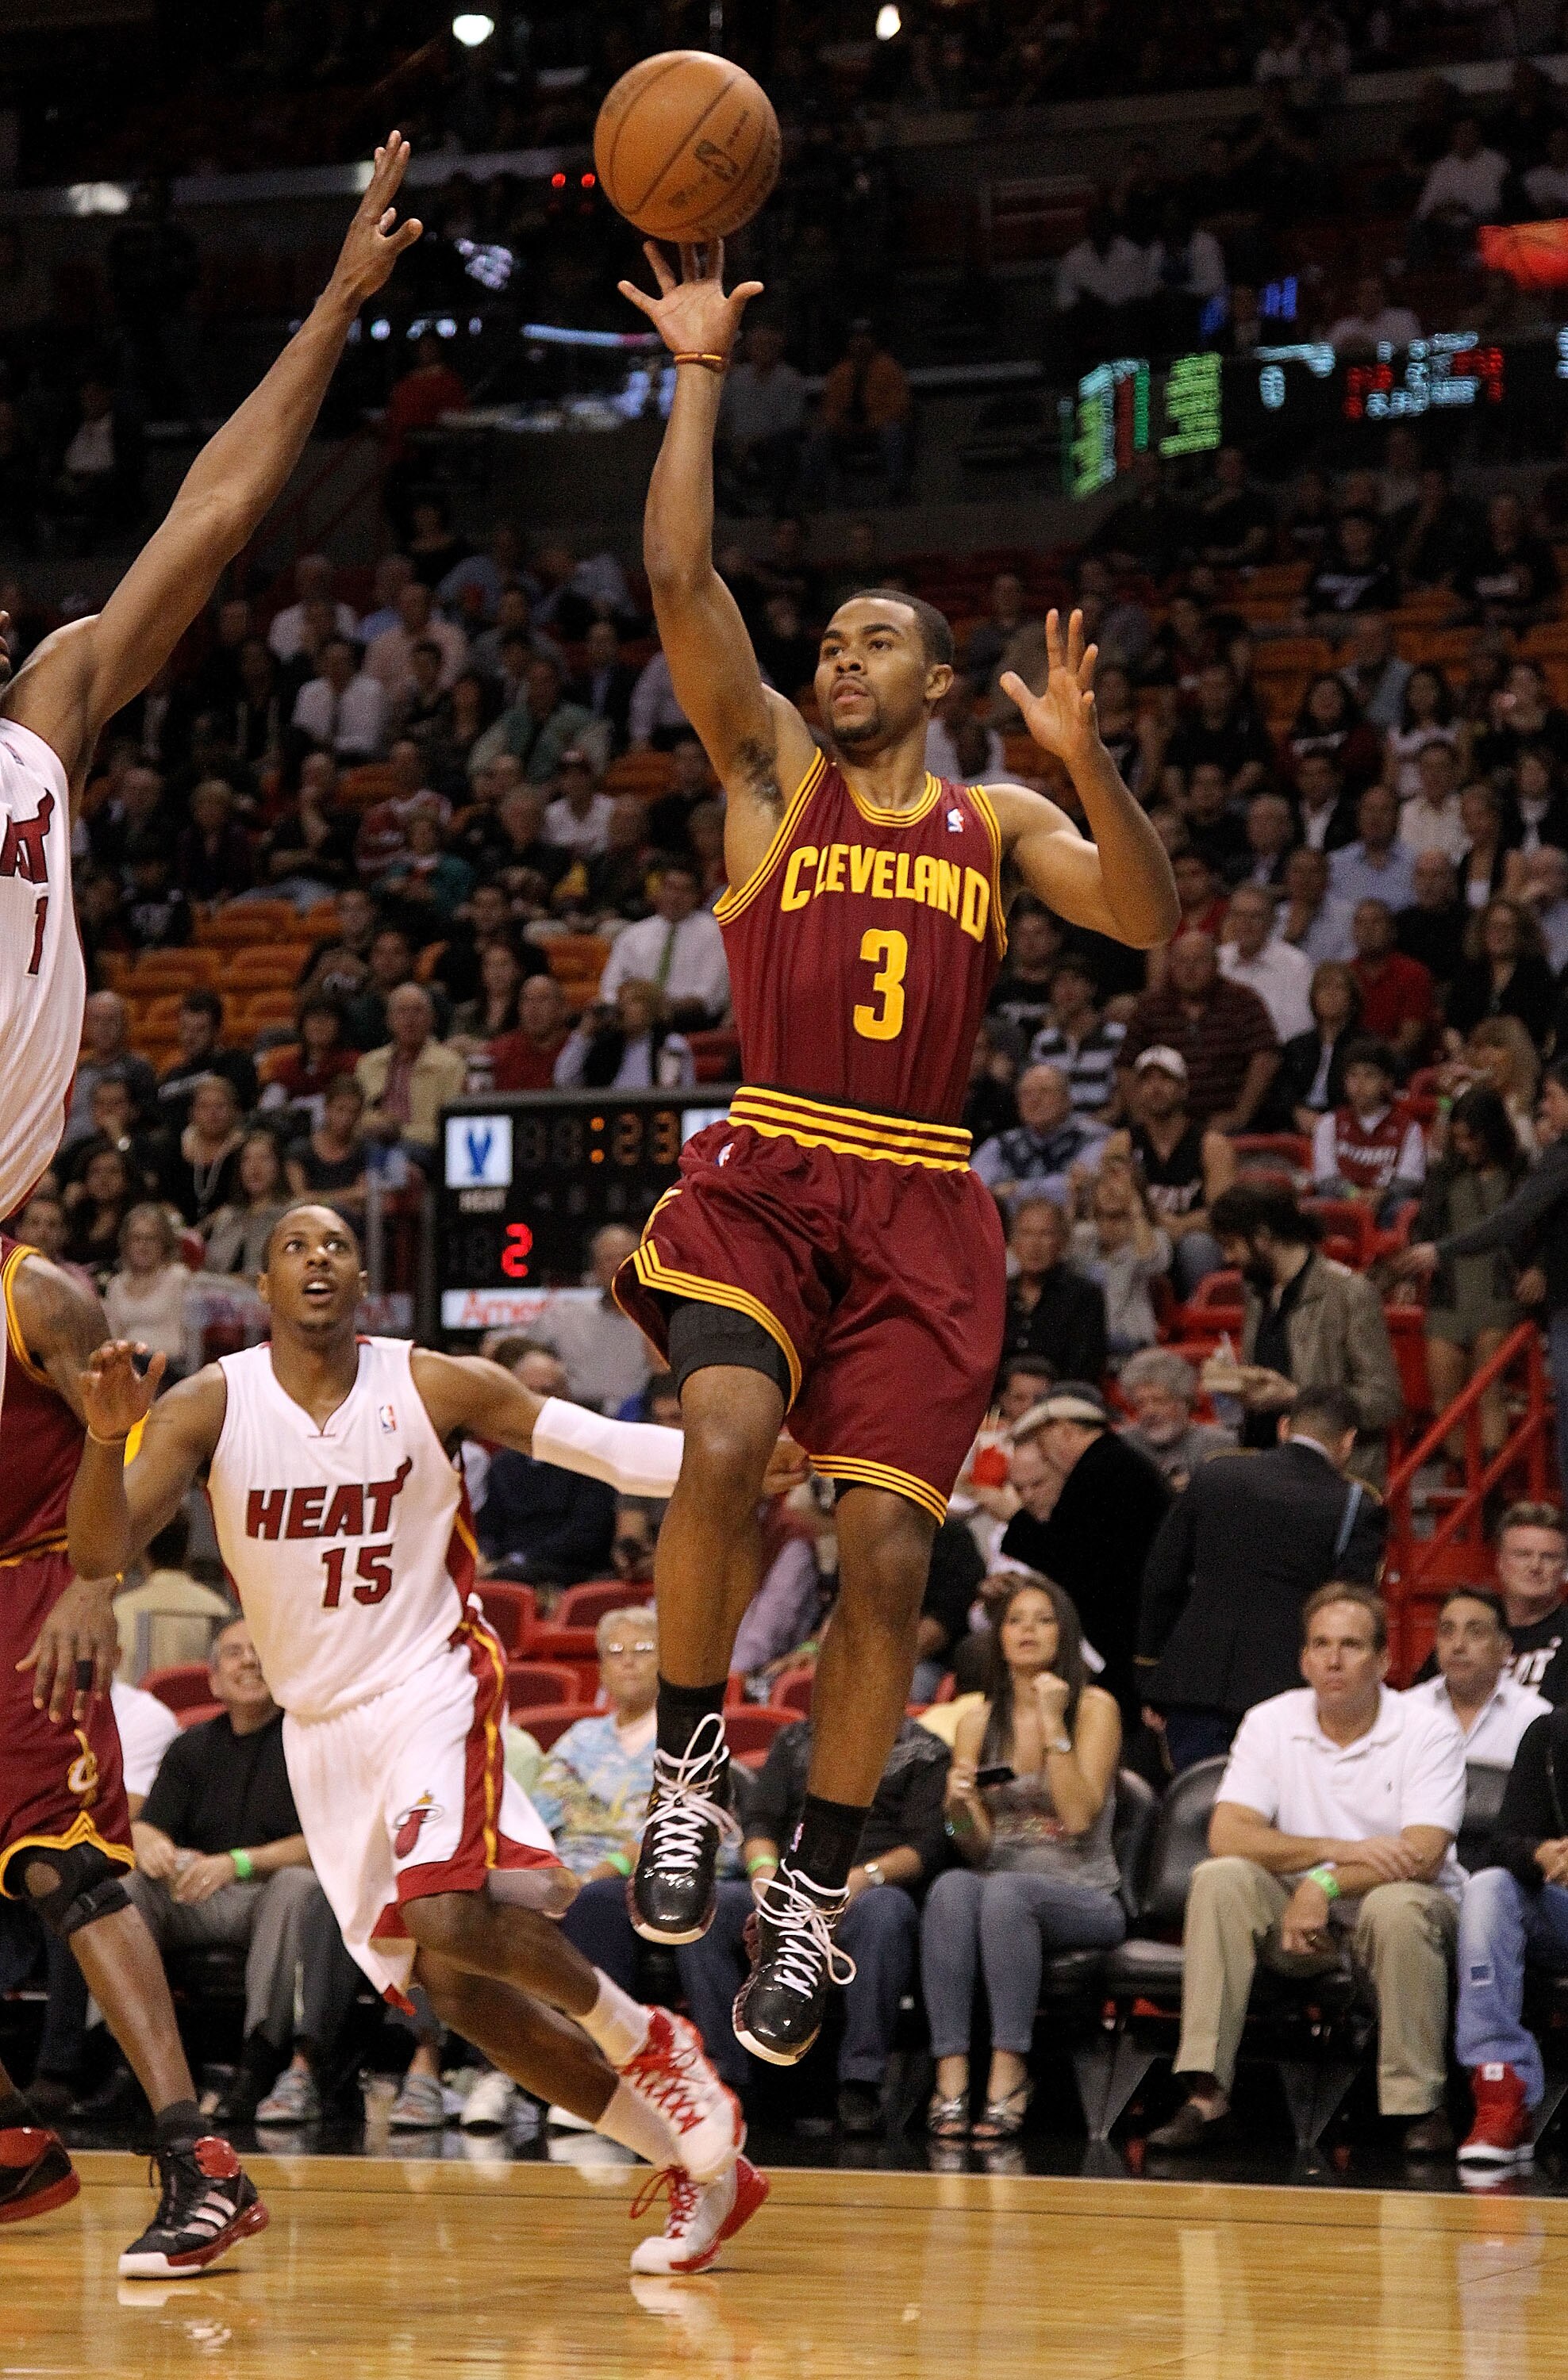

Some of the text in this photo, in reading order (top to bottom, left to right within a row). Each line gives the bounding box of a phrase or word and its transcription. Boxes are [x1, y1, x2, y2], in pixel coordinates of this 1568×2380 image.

[781, 844, 990, 942] CLEVELAND
[854, 927, 909, 1041] 3
[501, 1222, 533, 1279] 2
[246, 1457, 413, 1541] HEAT
[321, 1544, 394, 1609] 15
